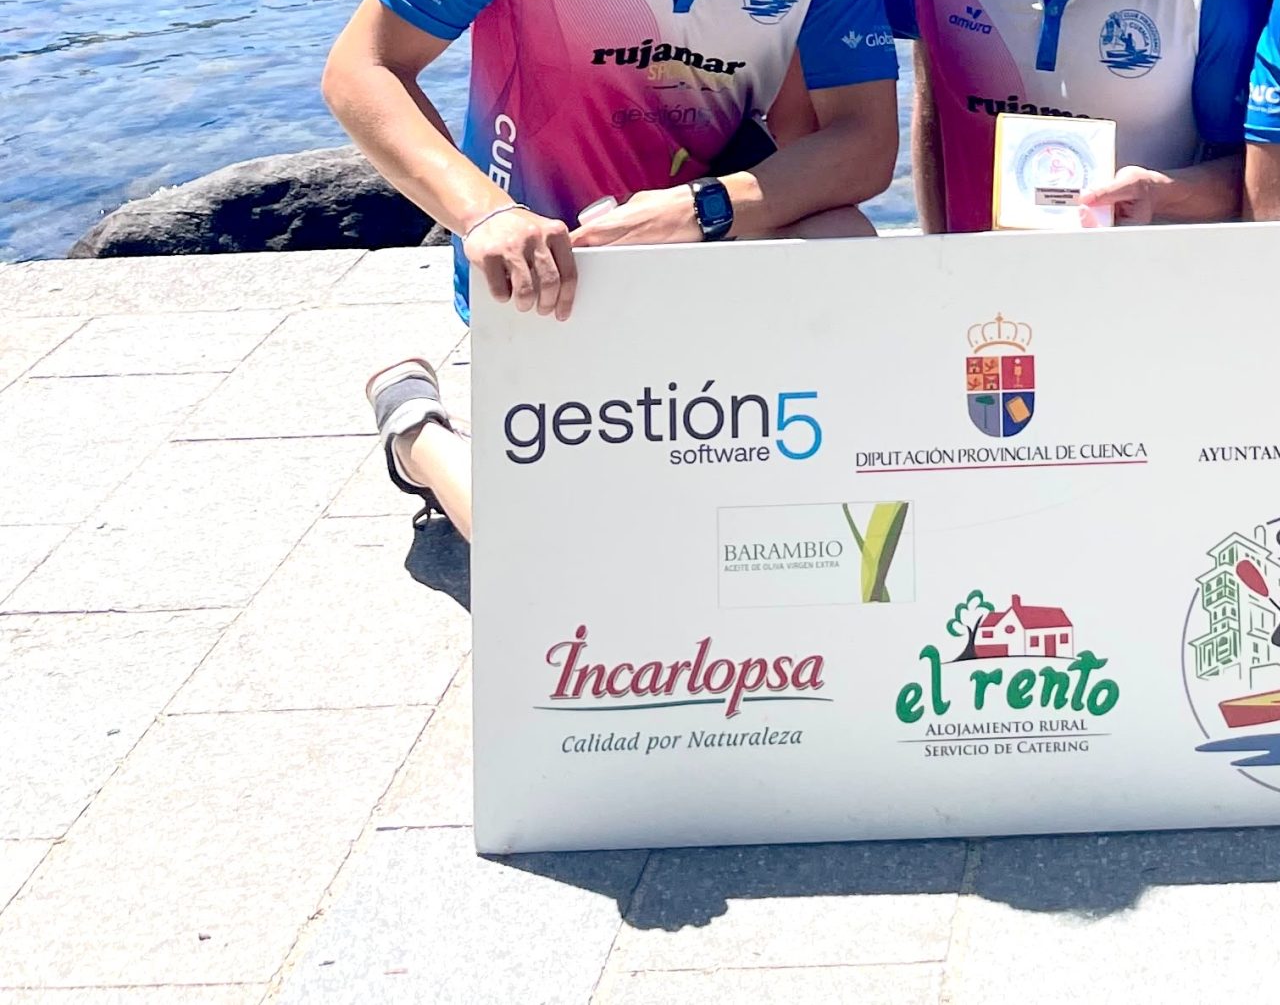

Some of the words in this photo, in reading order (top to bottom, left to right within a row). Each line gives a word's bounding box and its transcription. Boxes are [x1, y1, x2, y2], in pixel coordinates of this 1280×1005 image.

[949, 15, 992, 34] amura
[591, 39, 746, 75] rujamar
[966, 95, 1105, 118] ruja
[489, 114, 516, 194] CUE
[504, 380, 822, 464] gestión5
[669, 444, 770, 465] software
[856, 447, 954, 467] DIPUTACIÓN
[958, 444, 1052, 464] PROVINCIAL
[1056, 444, 1076, 460] DE
[1080, 443, 1147, 459] CUENCA
[724, 540, 843, 562] BARAMBIO
[724, 563, 749, 572] ACEITE
[752, 563, 761, 571] DE
[763, 562, 784, 571] OLIVA
[787, 561, 814, 570] VIRGEN
[816, 560, 840, 569] EXTRA
[545, 624, 825, 719] Incarlopsa
[895, 644, 951, 723] el
[969, 650, 1120, 716] rento
[925, 720, 1034, 737] ALOJAMIENTO
[1039, 719, 1088, 732] RURAL
[561, 732, 639, 753] Calidad
[646, 735, 681, 754] por
[687, 727, 803, 748] Naturaleza
[924, 743, 989, 757] SERVICIO
[994, 743, 1013, 755] DE
[1017, 740, 1090, 754] CATERING
